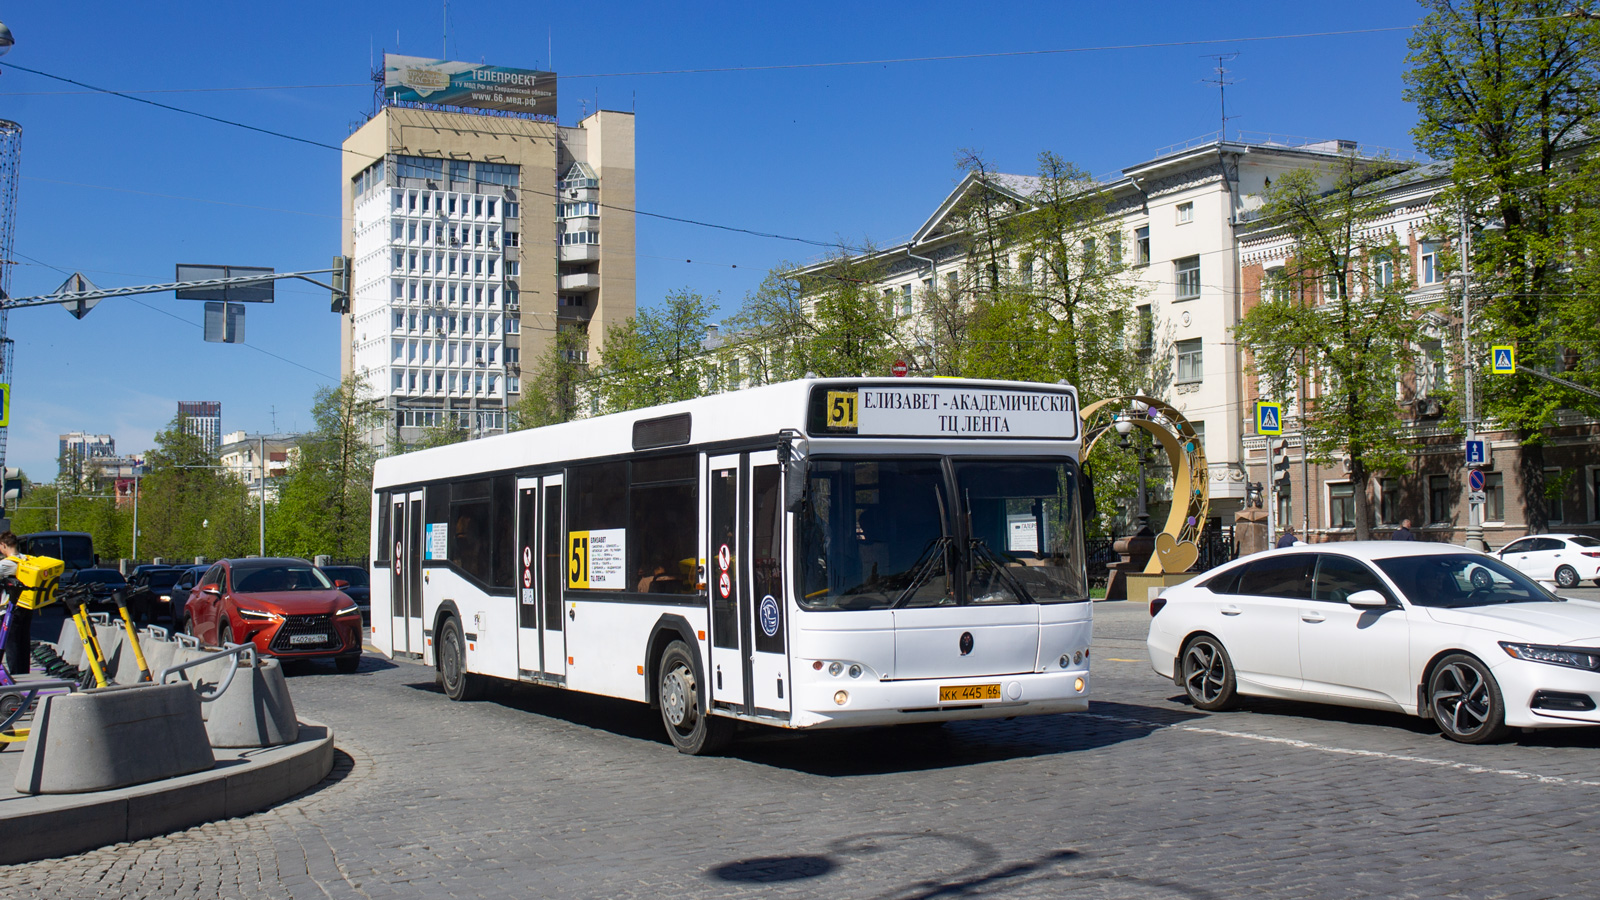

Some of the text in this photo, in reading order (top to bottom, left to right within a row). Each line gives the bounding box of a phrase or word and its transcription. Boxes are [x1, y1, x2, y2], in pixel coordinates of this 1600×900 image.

[471, 69, 536, 86] ТЕЛЕПРОЕКТ
[463, 82, 476, 90] МВД
[494, 85, 530, 95] Свердловской
[531, 89, 552, 97] области
[472, 92, 536, 107] www.66.мвд.рф
[832, 397, 853, 422] 51
[864, 392, 940, 410] ЕЛИЗАВЕТ
[950, 394, 1074, 412] АКАДЕМИЧЕСКИ
[938, 415, 1010, 434] ТЦ ЛЕНТА
[572, 538, 588, 582] 51
[962, 687, 982, 699] 445
[987, 684, 998, 695] 66
